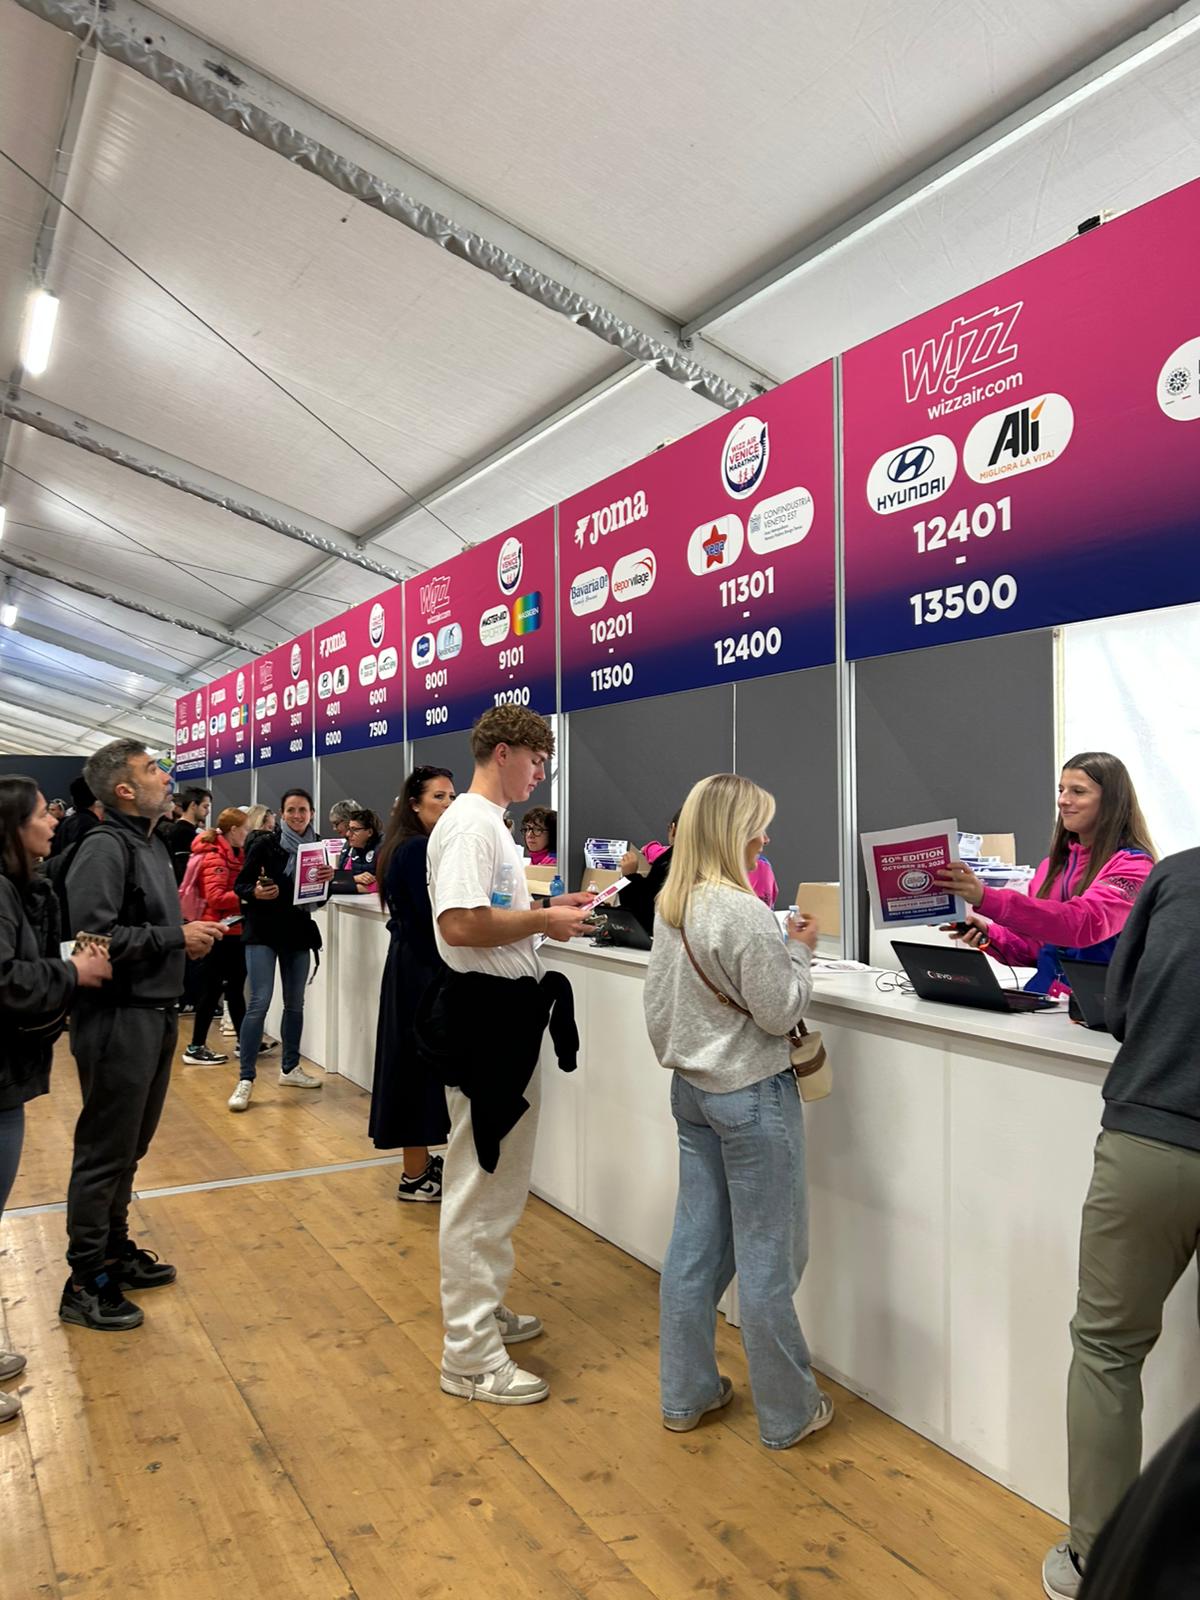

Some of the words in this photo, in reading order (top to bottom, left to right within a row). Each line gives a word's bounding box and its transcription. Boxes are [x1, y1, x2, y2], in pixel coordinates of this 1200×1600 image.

[927, 372, 1023, 420] wizzair.com
[987, 398, 1046, 467] Ali
[729, 443, 760, 465] VENICE
[731, 442, 746, 453] WIZZ
[747, 436, 757, 447] AIR
[729, 454, 760, 472] MARATHON
[979, 461, 1019, 480] MIGLIORA
[1020, 457, 1032, 469] LA
[1033, 450, 1056, 465] VITA!
[877, 476, 946, 511] HYUNDAI
[763, 496, 811, 520] CONFINDUSTRIA
[764, 514, 786, 529] VENETO
[786, 510, 797, 521] EST
[913, 496, 1011, 553] 12401
[571, 579, 599, 600] Bavaria
[613, 572, 649, 594] deporvillage
[719, 566, 774, 608] 11301
[910, 574, 1018, 626] 13500
[590, 611, 633, 645] 10201
[499, 645, 524, 669] 9101
[714, 626, 782, 666] 12400
[425, 669, 448, 690] 8001
[591, 662, 634, 692] 11300
[369, 687, 387, 706] 6001
[425, 705, 448, 726] 9100
[325, 730, 341, 746] 6000
[369, 720, 388, 738] 7500
[902, 849, 944, 862] EDITION
